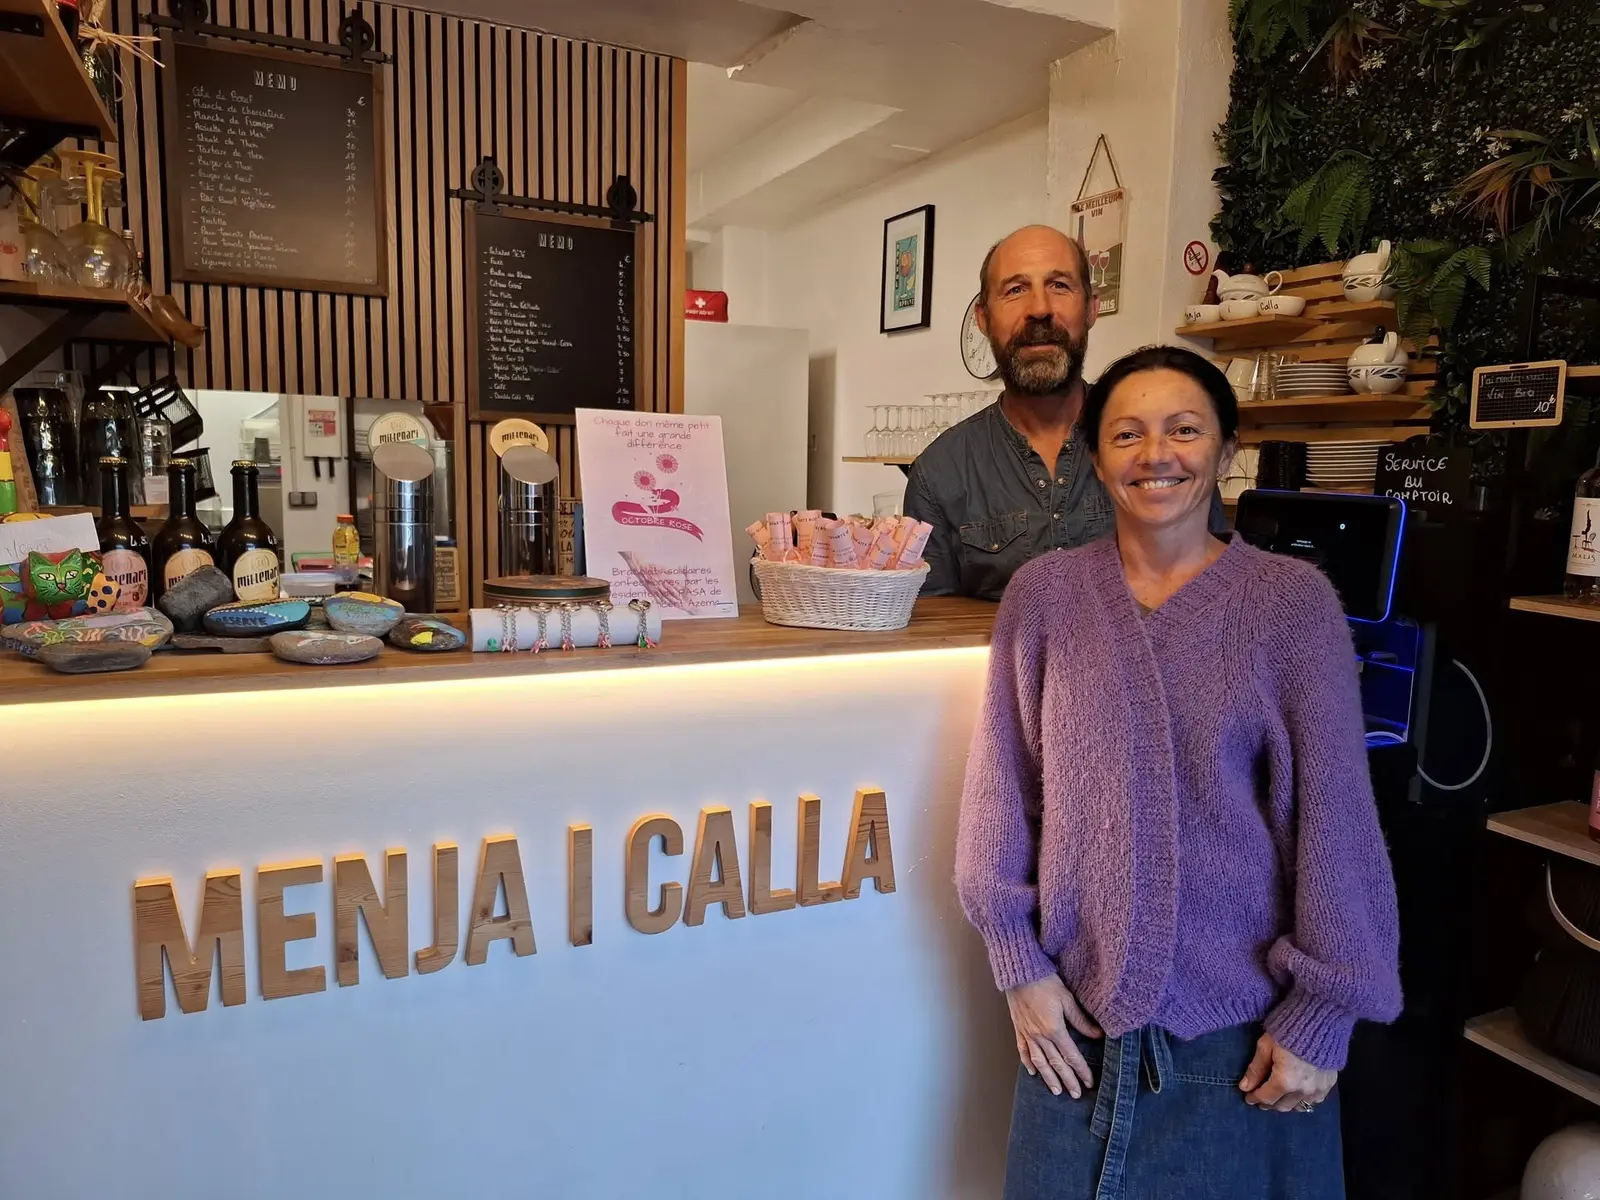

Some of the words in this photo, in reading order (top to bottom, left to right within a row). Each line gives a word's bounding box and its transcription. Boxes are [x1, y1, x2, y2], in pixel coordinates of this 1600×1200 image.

[1091, 208, 1104, 218] VIN
[1099, 300, 1116, 311] MIS
[1259, 300, 1279, 311] Calla
[593, 416, 631, 429] Chaque
[634, 417, 654, 428] don
[655, 420, 684, 430] même
[688, 420, 711, 433] petit
[615, 427, 634, 438] fait
[637, 430, 655, 439] une
[658, 430, 692, 444] grande
[621, 517, 665, 526] OCTOBRE
[669, 520, 694, 532] ROSE
[685, 579, 702, 589] par
[705, 577, 719, 586] les
[678, 587, 706, 597] PASA
[710, 586, 722, 596] de
[134, 832, 537, 1021] MENJA
[569, 823, 593, 947] I
[625, 787, 897, 935] CALLA
